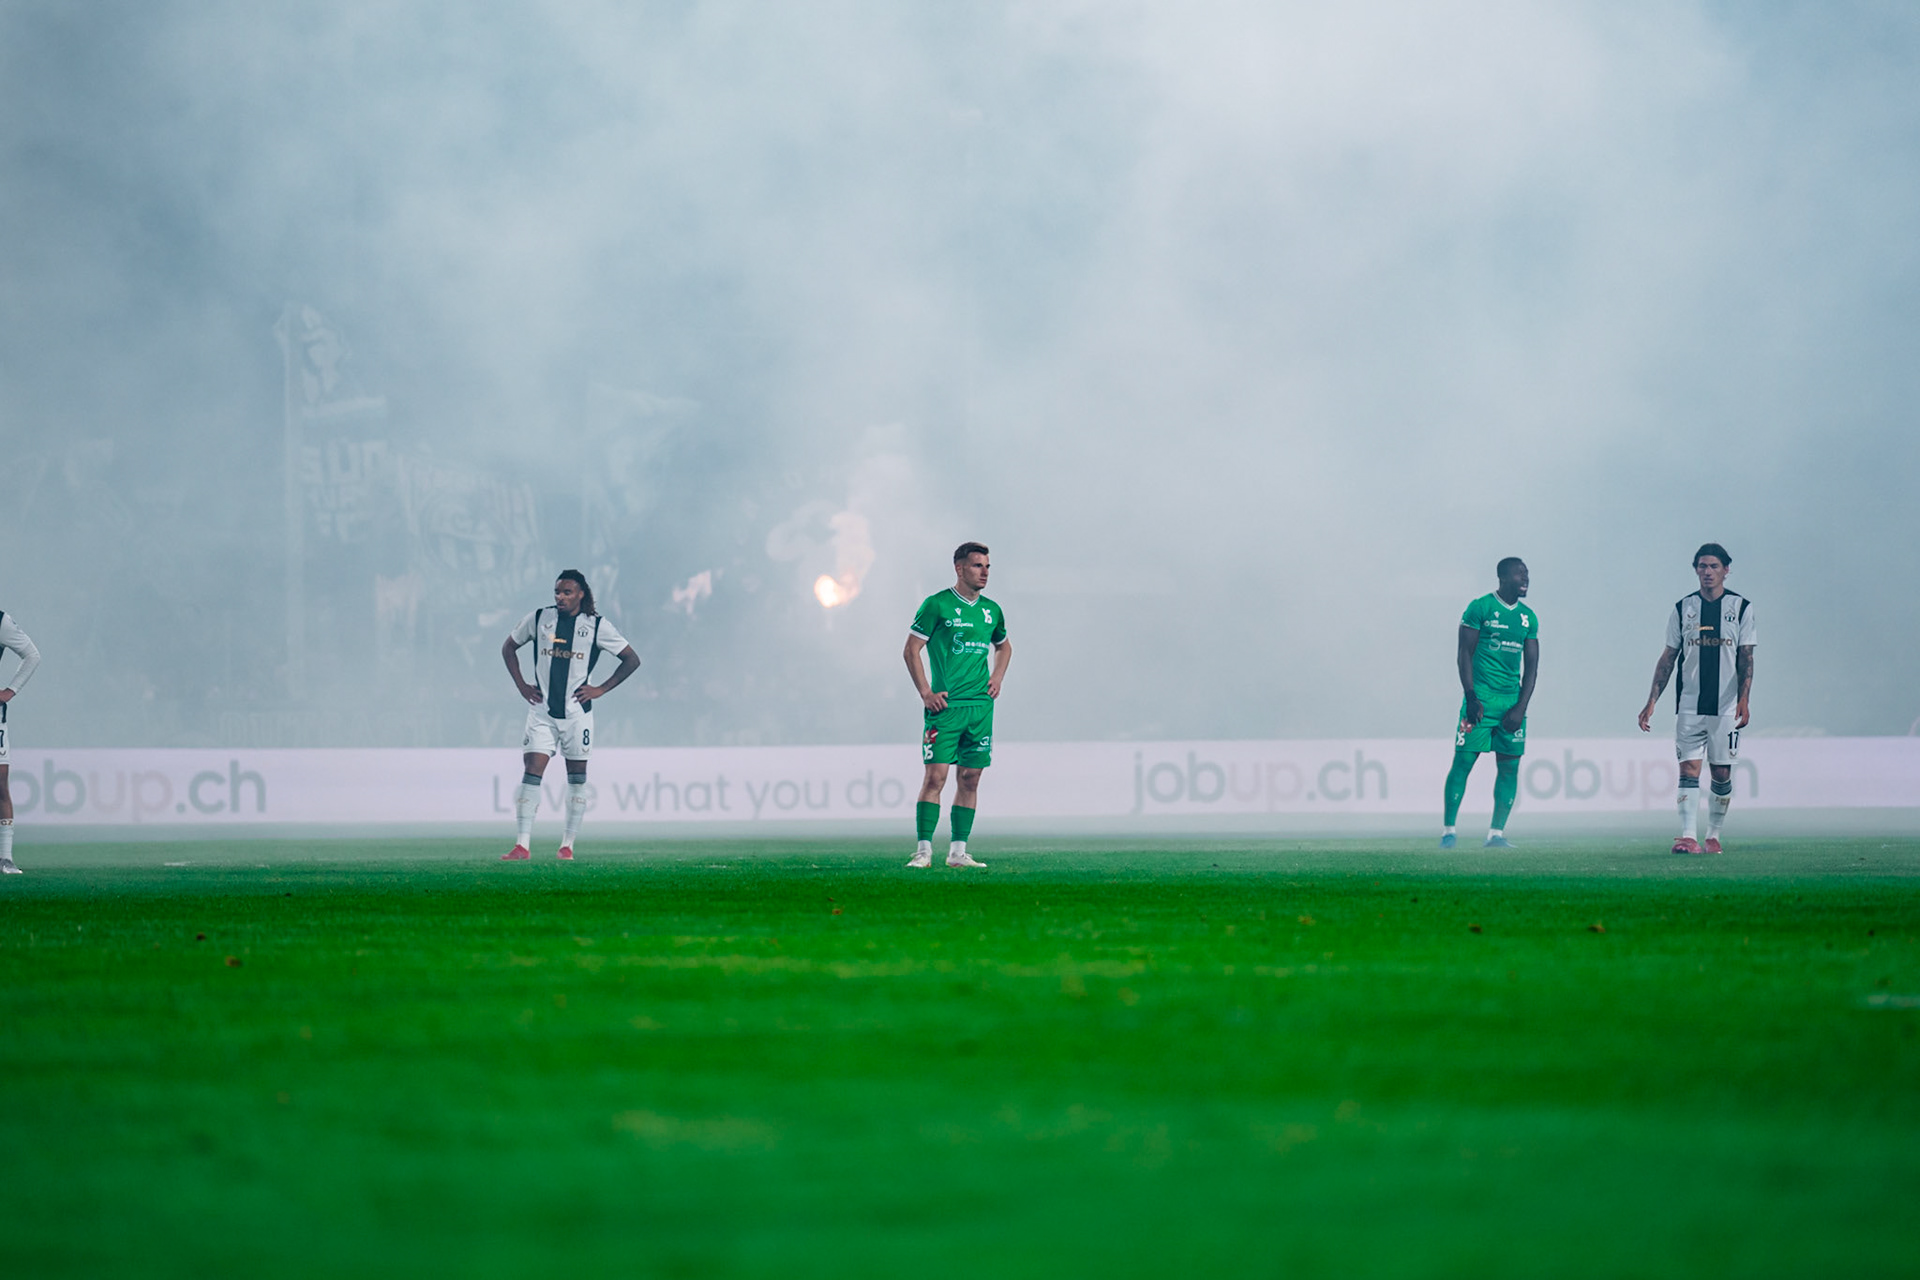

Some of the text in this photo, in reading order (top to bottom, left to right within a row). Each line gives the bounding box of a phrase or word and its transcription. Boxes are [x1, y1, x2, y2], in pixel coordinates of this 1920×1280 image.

[1688, 635, 1733, 646] nokera
[541, 647, 585, 660] nokera
[582, 728, 590, 746] 8
[1727, 731, 1739, 750] 17
[9, 759, 267, 823] obup.ch
[1129, 749, 1389, 814] jobup.ch
[612, 772, 732, 813] what
[745, 779, 831, 821] you
